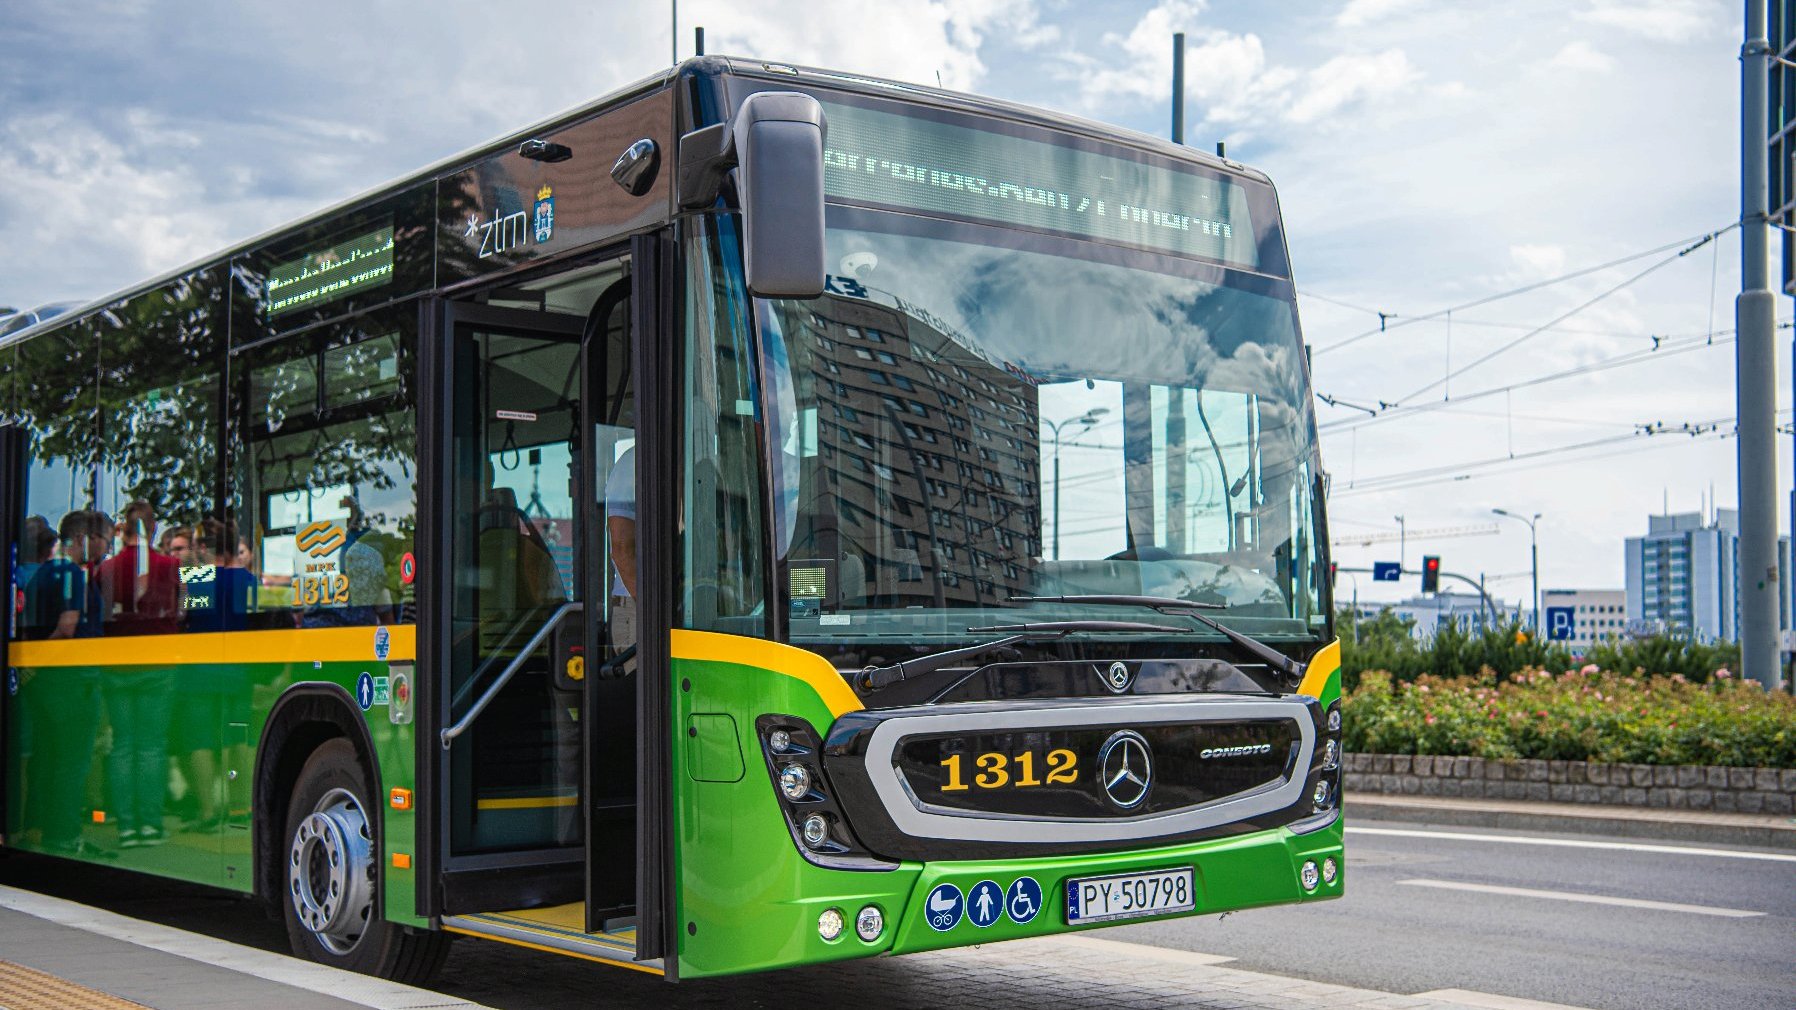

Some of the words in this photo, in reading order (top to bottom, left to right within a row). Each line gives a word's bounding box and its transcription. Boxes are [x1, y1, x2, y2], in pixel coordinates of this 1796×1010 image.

[305, 562, 337, 573] MPK
[291, 574, 349, 606] 1312
[1553, 611, 1569, 637] P
[1200, 743, 1271, 759] CONECTO
[940, 749, 1079, 791] 1312
[1083, 882, 1113, 916] PY
[1121, 875, 1187, 911] 50798
[1069, 906, 1079, 915] PL
